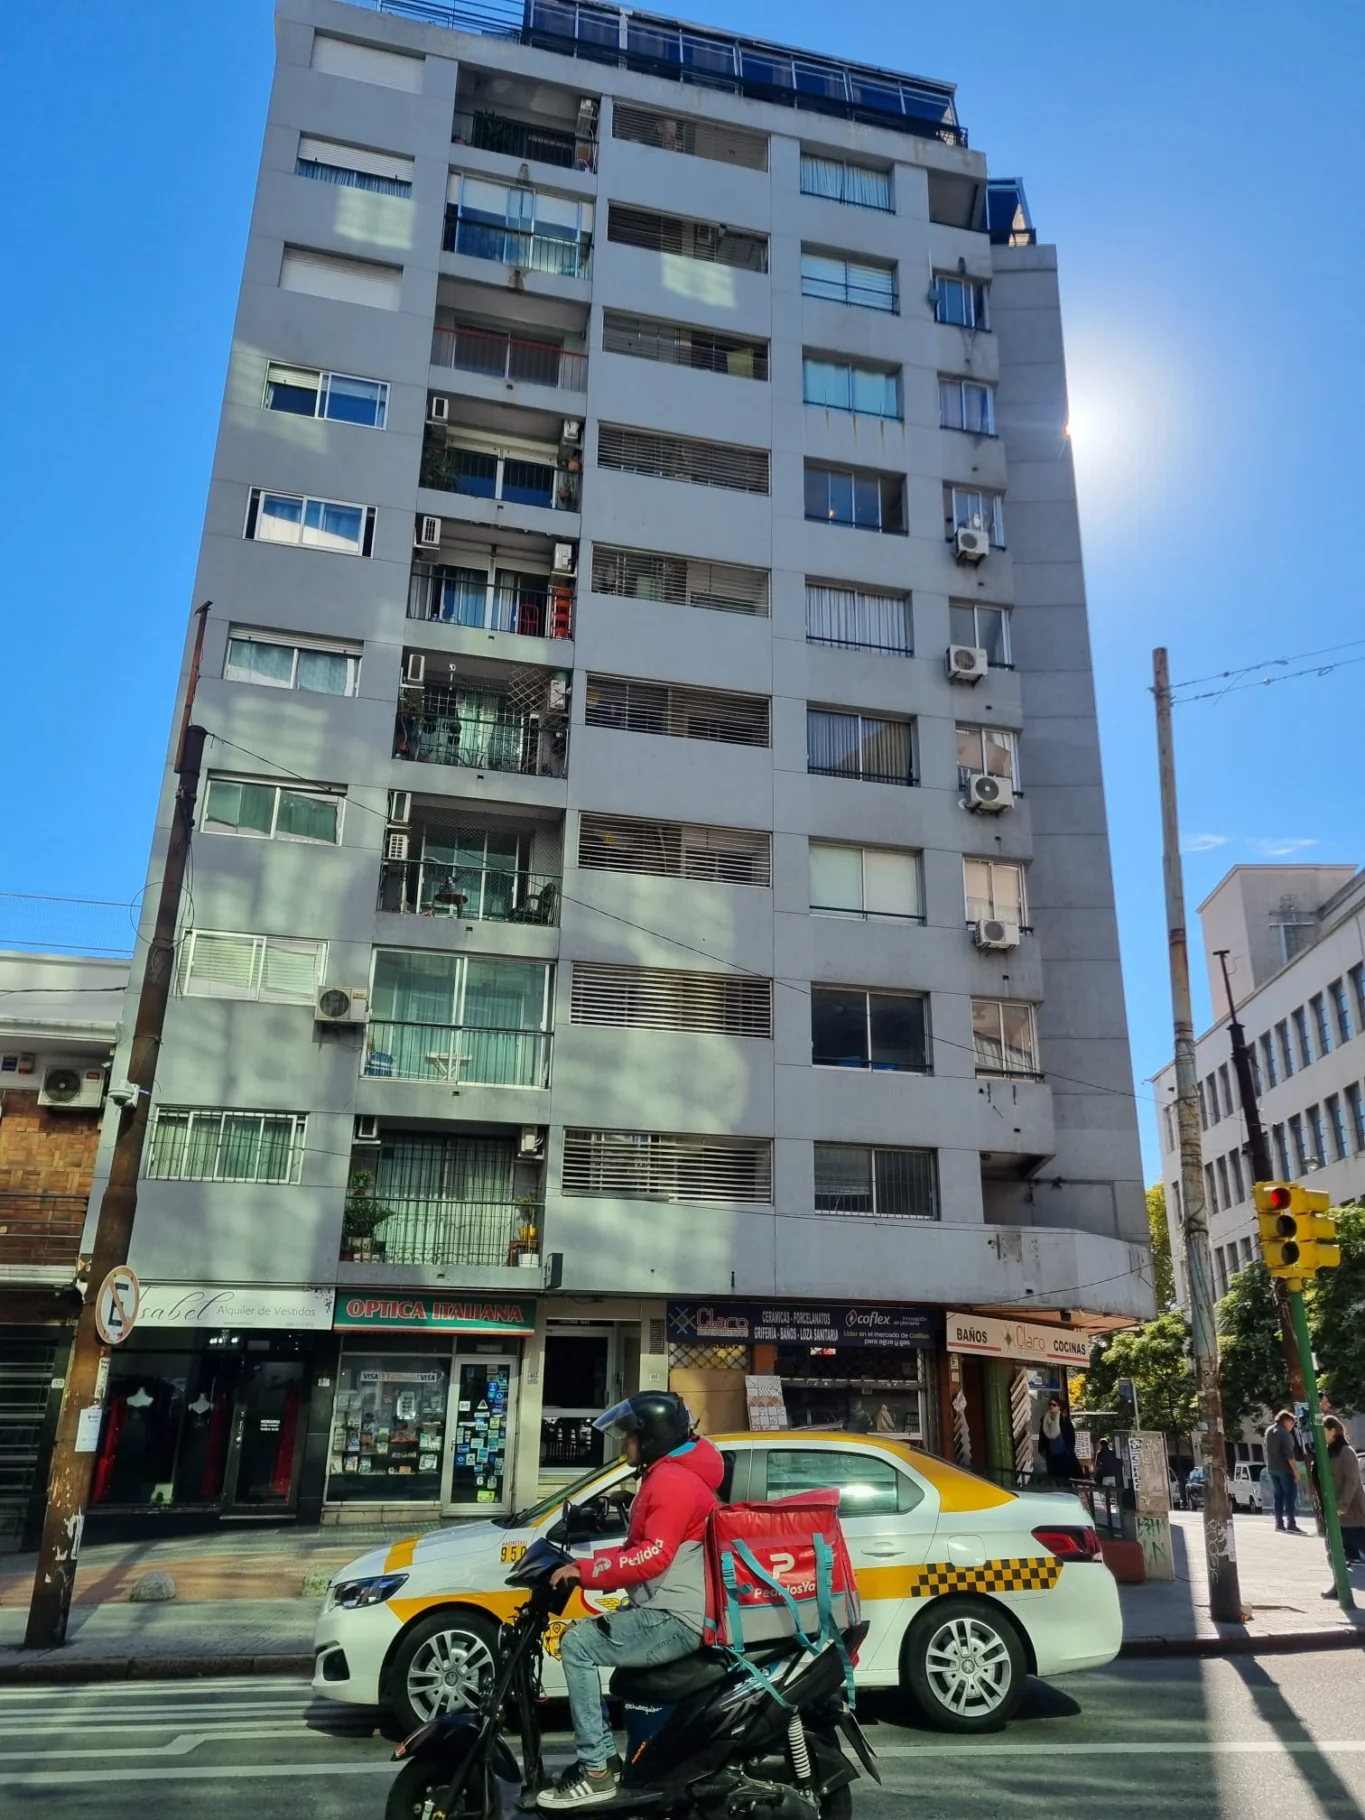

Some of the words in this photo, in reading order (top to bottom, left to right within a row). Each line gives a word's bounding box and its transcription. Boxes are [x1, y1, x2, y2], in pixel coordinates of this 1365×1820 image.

[217, 1304, 256, 1317] Alquiler
[258, 1306, 271, 1316] de
[274, 1306, 316, 1317] Vestidos
[346, 1299, 427, 1320] OPTICA
[431, 1301, 525, 1323] ITALIANA
[697, 1307, 749, 1329] Claro
[762, 1309, 790, 1324] CERÁMICAS
[793, 1311, 831, 1326] PORCELANATOS
[857, 1311, 890, 1327] coflex
[780, 1325, 797, 1341] BAÑOS
[800, 1327, 813, 1341] LOZA
[814, 1328, 838, 1342] SANITARIA
[956, 1327, 988, 1343] BAÑOS
[1015, 1326, 1046, 1350] Claro
[1053, 1339, 1087, 1356] COCINAS
[754, 1581, 816, 1599] PedosYa
